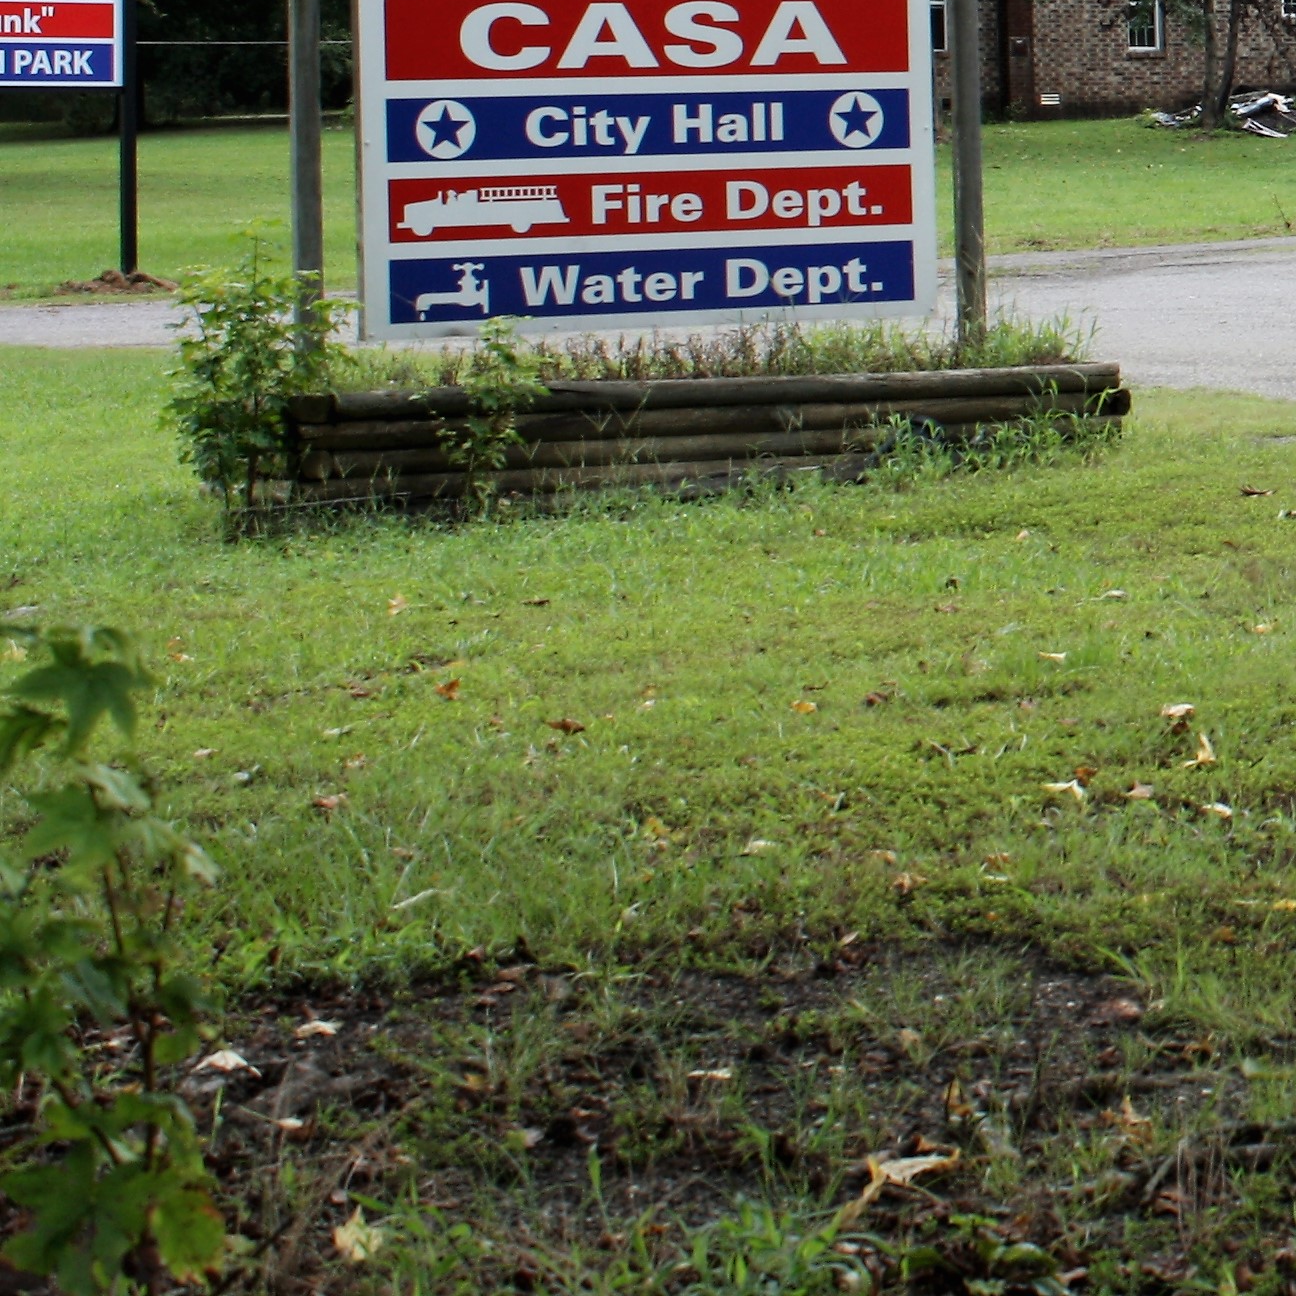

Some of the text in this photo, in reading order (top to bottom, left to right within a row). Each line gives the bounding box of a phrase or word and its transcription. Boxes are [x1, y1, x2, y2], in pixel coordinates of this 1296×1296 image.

[0, 6, 54, 34] nk"
[459, 0, 848, 71] CASA
[13, 49, 94, 75] PARK
[525, 102, 784, 154] City Hall
[591, 180, 884, 227] Fire Dept.
[519, 256, 884, 307] Water Dept.
